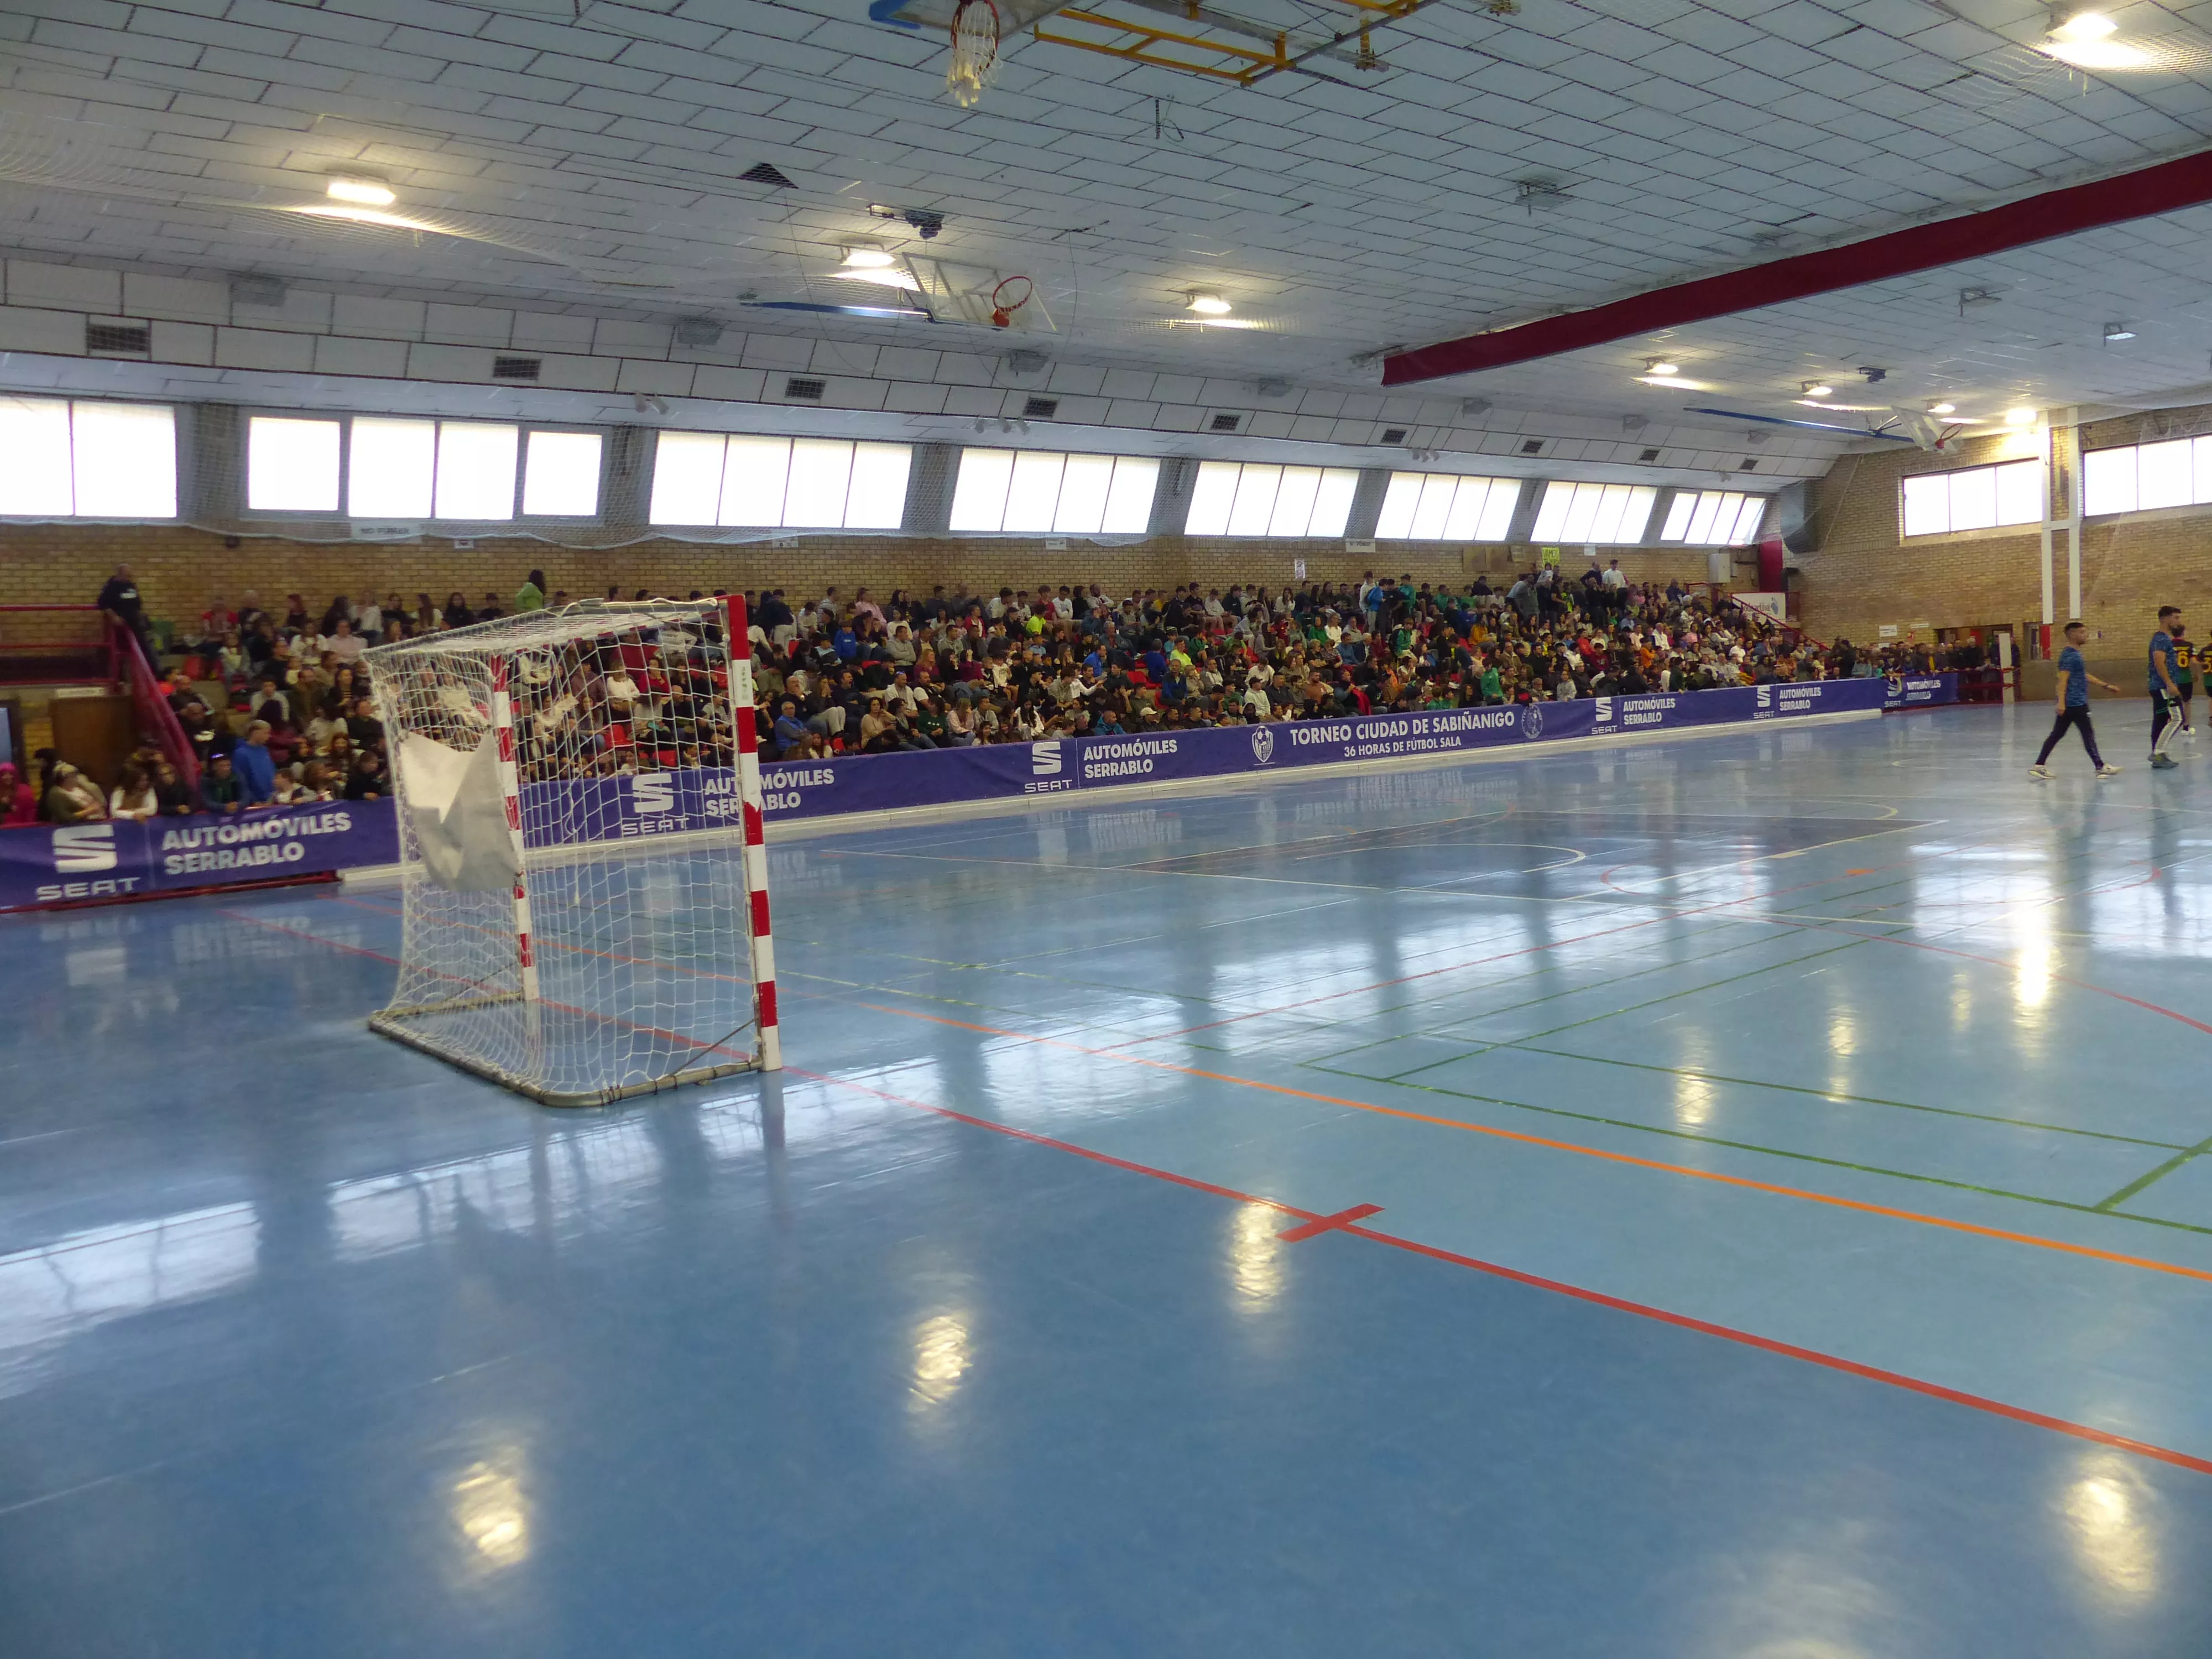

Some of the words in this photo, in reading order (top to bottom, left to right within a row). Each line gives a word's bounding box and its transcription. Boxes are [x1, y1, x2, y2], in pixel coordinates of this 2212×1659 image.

[2177, 651, 2189, 668] 6
[1779, 686, 1822, 699] AUTOMÓVILES
[1623, 696, 1676, 712] AUTOMÓVILES
[1780, 700, 1811, 711] SERRABLO
[1290, 725, 1352, 745] TORNEO
[1356, 720, 1408, 739] CIUDAD
[1412, 718, 1429, 735] DE
[1433, 711, 1515, 733] SABIÑANIGO
[1624, 712, 1662, 725] SERRABLO
[1592, 725, 1618, 734] SEAT
[1083, 738, 1178, 761] AUTOMÓVILES
[1344, 746, 1356, 757] 36
[1358, 742, 1390, 755] HORAS
[1392, 741, 1404, 752] DE
[1406, 737, 1438, 751] FÚTBOL
[1440, 736, 1462, 748] SALA
[1084, 759, 1154, 779] SERRABLO
[705, 768, 835, 795] AUTMÓVILES
[1024, 779, 1073, 793] SEAT
[706, 792, 801, 816] SERABLO
[162, 812, 352, 851] AUTOMÓVILES
[621, 817, 690, 836] SEAT
[165, 842, 305, 875] SERRABLO
[36, 877, 140, 901] SEAT
